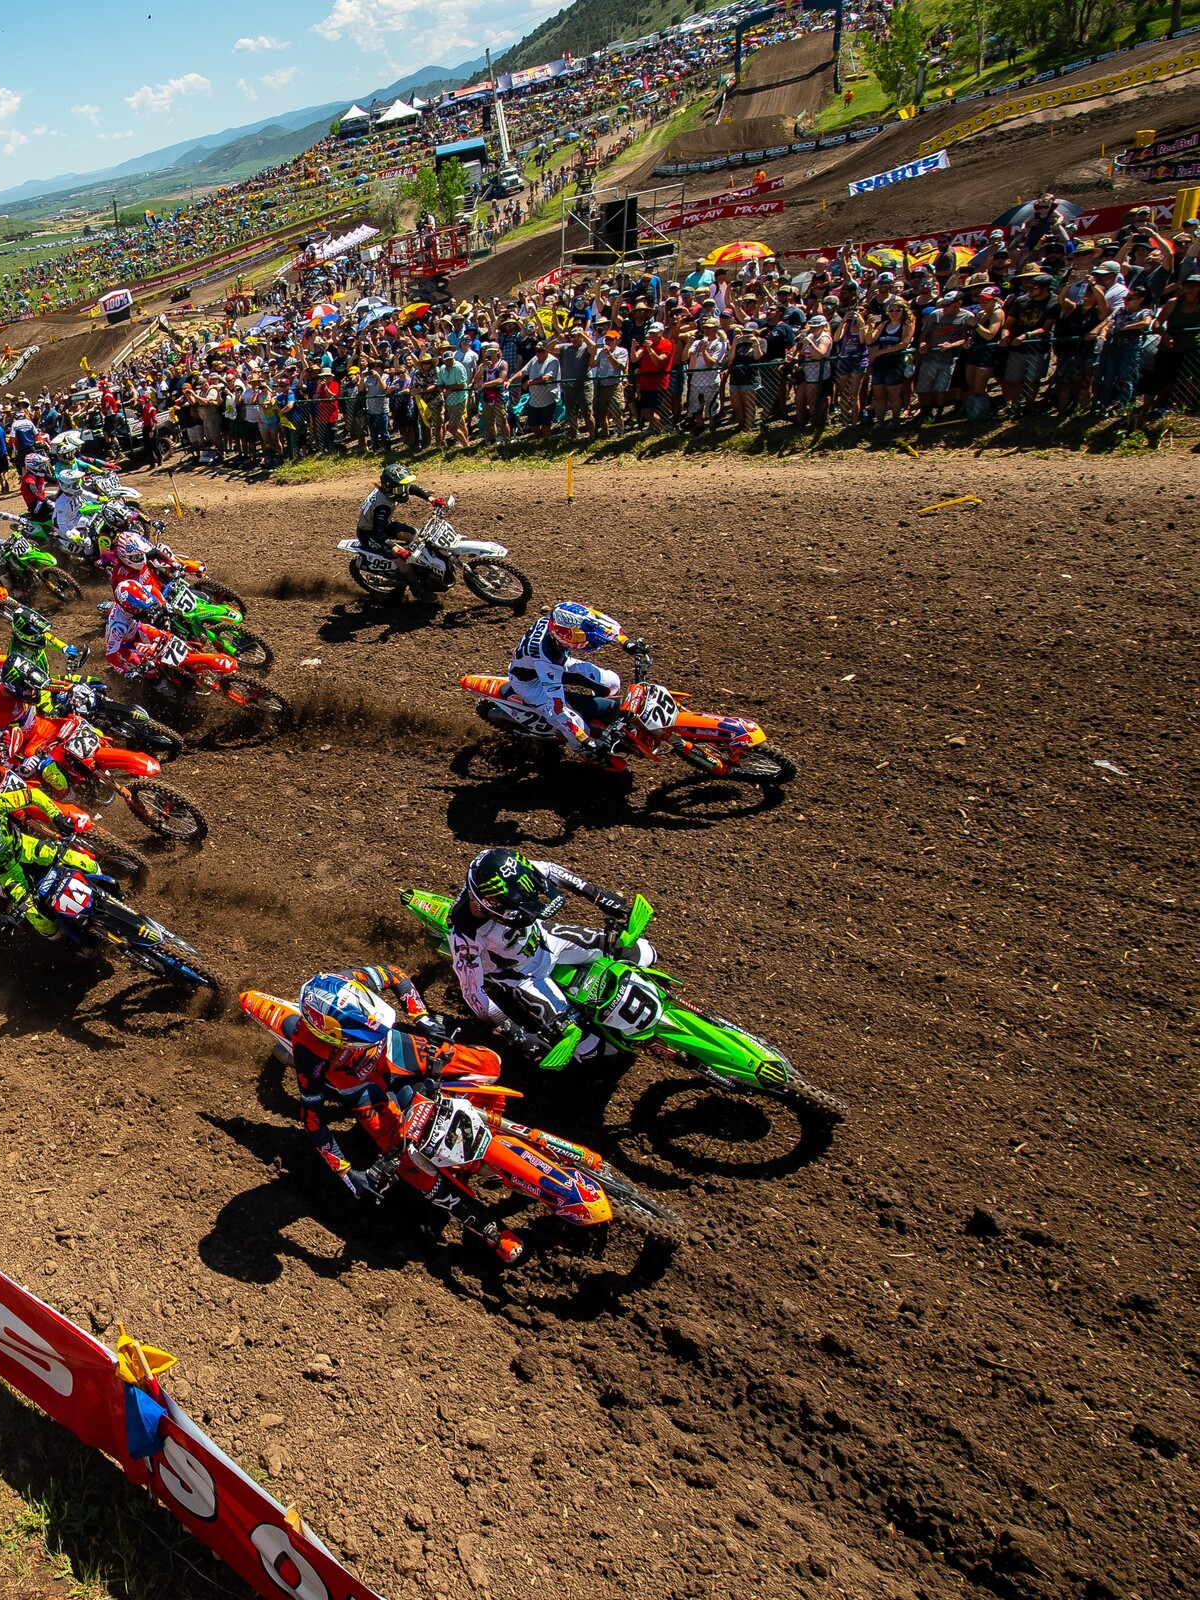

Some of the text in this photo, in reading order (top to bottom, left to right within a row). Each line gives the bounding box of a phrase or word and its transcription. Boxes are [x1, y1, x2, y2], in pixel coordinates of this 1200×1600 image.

[989, 81, 1020, 95] GEICO
[819, 135, 846, 145] GEICO
[850, 127, 879, 138] GEICO
[766, 147, 789, 156] GEICO
[792, 141, 816, 150] GEICO
[382, 167, 414, 179] LUCAS OIL
[856, 154, 940, 192] PARTS
[683, 209, 723, 224] MX-ATV
[735, 202, 778, 215] MX-ATV
[105, 294, 129, 311] 100%
[438, 525, 457, 548] 951
[372, 559, 392, 571] 951
[177, 589, 195, 613] 57
[529, 616, 550, 659] USQUIN
[165, 640, 188, 666] 72
[652, 690, 676, 728] 25
[521, 711, 554, 732] 25
[74, 726, 98, 758] 23
[550, 865, 588, 891] Kawas
[58, 877, 93, 914] 14
[602, 896, 623, 910] FOX
[608, 985, 626, 1011] LUCAS OIL
[619, 984, 659, 1031] 9
[413, 1104, 433, 1140] RENTHAL
[445, 1110, 483, 1162] 2
[521, 1150, 553, 1175] RedBull
